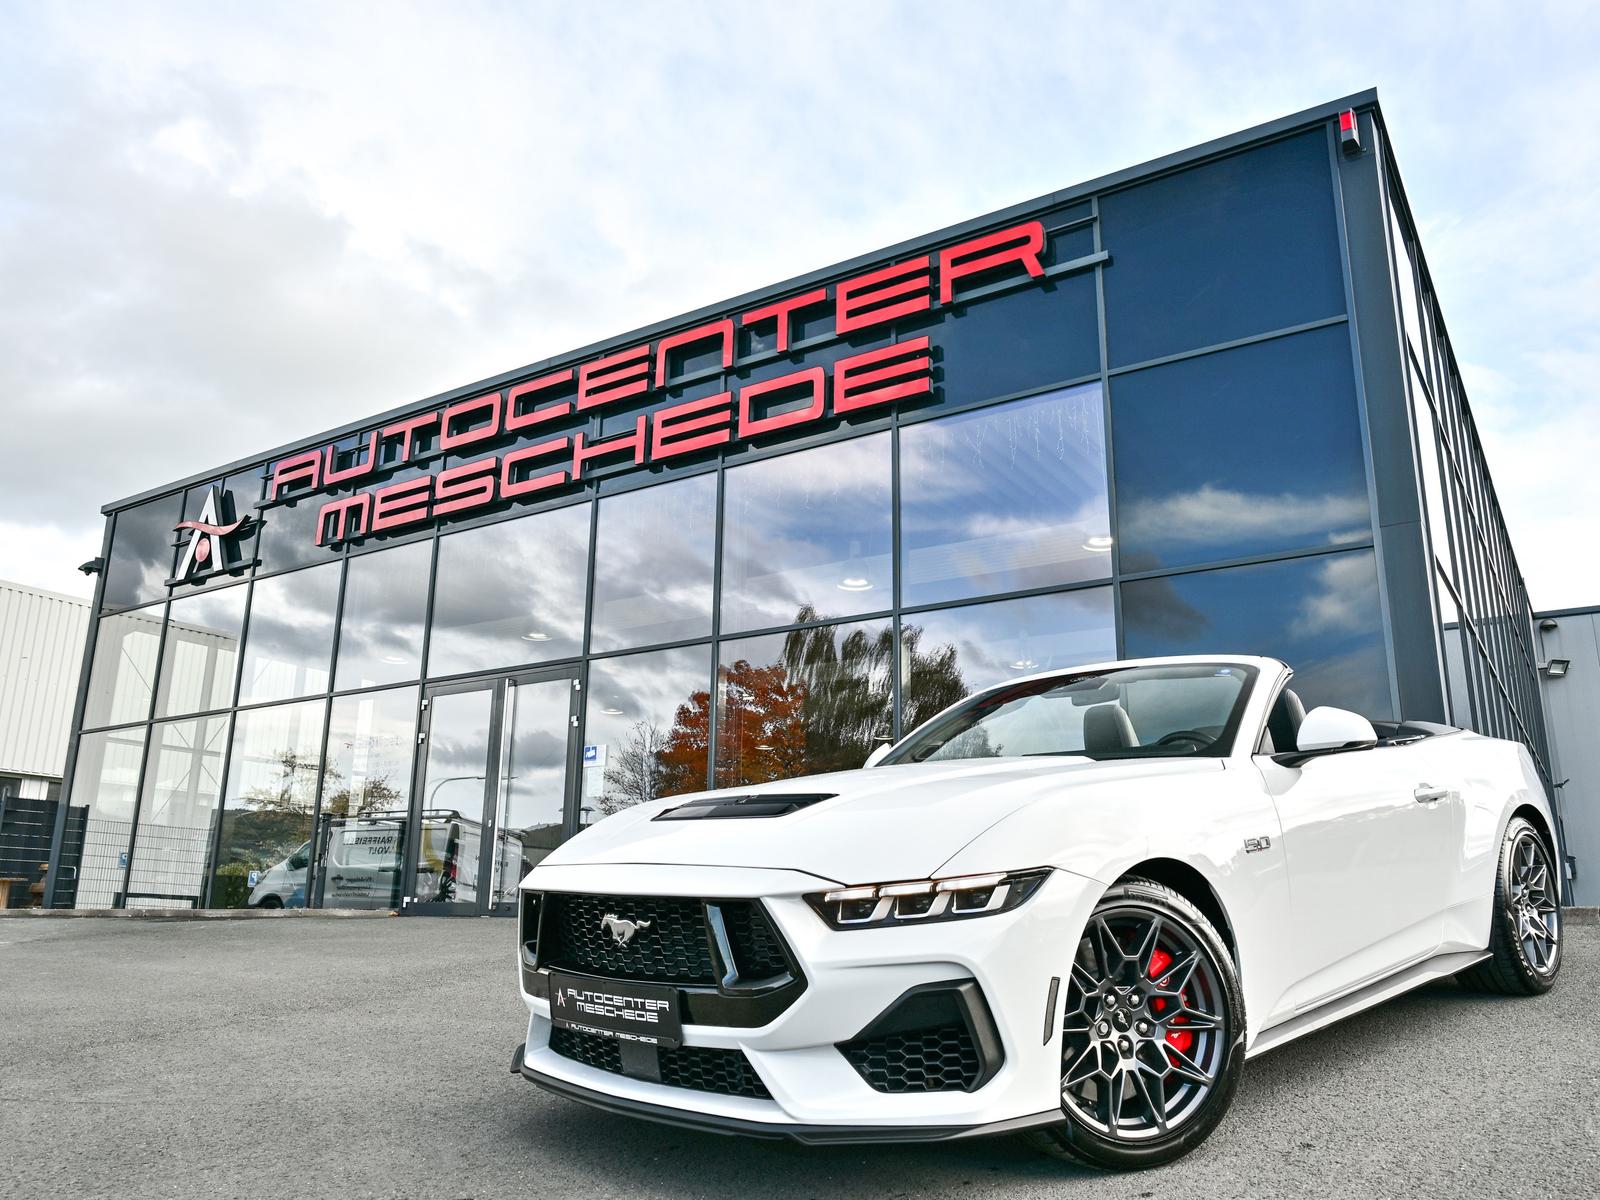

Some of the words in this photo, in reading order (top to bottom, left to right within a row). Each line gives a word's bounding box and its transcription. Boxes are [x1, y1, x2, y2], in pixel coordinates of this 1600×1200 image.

[270, 220, 1047, 502] AUTOCENTER
[315, 335, 932, 547] MESCHEDE
[567, 988, 670, 1012] AUTOCENTER
[576, 1001, 659, 1023] MESCHEDE
[570, 1023, 614, 1037] AUTOCENTER
